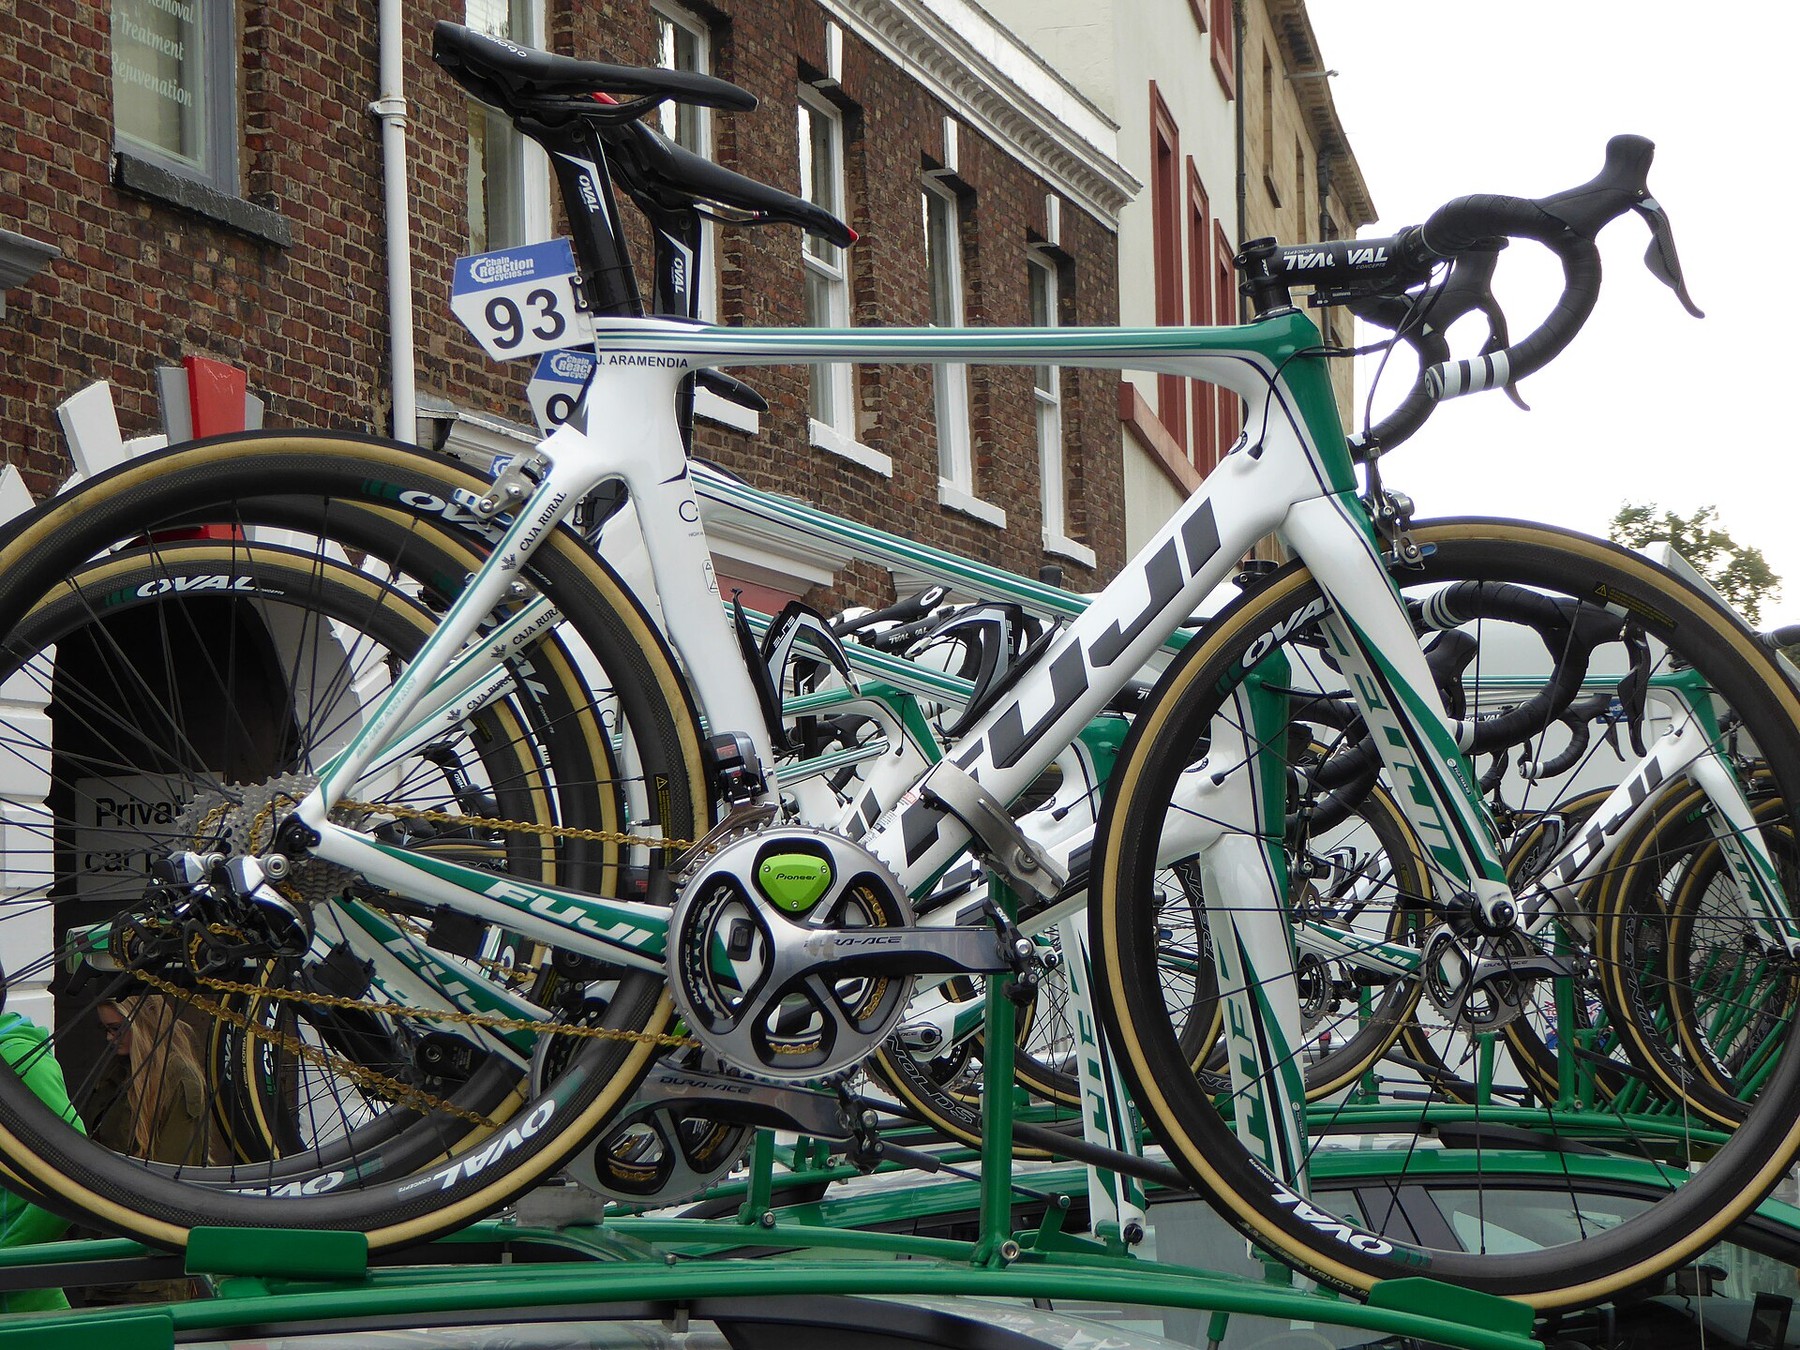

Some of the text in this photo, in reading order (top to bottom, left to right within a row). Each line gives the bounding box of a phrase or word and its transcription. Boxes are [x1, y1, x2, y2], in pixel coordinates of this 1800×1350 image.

[120, 12, 184, 61] Treatment
[111, 51, 192, 108] Rejuvenation
[579, 174, 599, 213] OVAL
[480, 258, 534, 278] Reaction
[486, 256, 510, 267] Chain
[673, 257, 685, 293] OVAL
[485, 289, 566, 350] 93
[558, 359, 593, 373] React
[567, 355, 590, 365] Chain
[609, 354, 689, 368] ARAMENDIA
[519, 491, 567, 552] CAJA RURAL
[137, 575, 256, 597] OVAL
[512, 606, 560, 645] CAJA RURA
[1243, 596, 1332, 668] OVA
[96, 795, 193, 827] Privat
[85, 849, 135, 873] car
[775, 872, 817, 881] Pioneer
[484, 880, 653, 947] FUJI
[1338, 935, 1412, 967] FUJI
[660, 1076, 752, 1094] DURA-ACE
[438, 1100, 555, 1190] OVAL
[1271, 1182, 1393, 1255] OVAL
